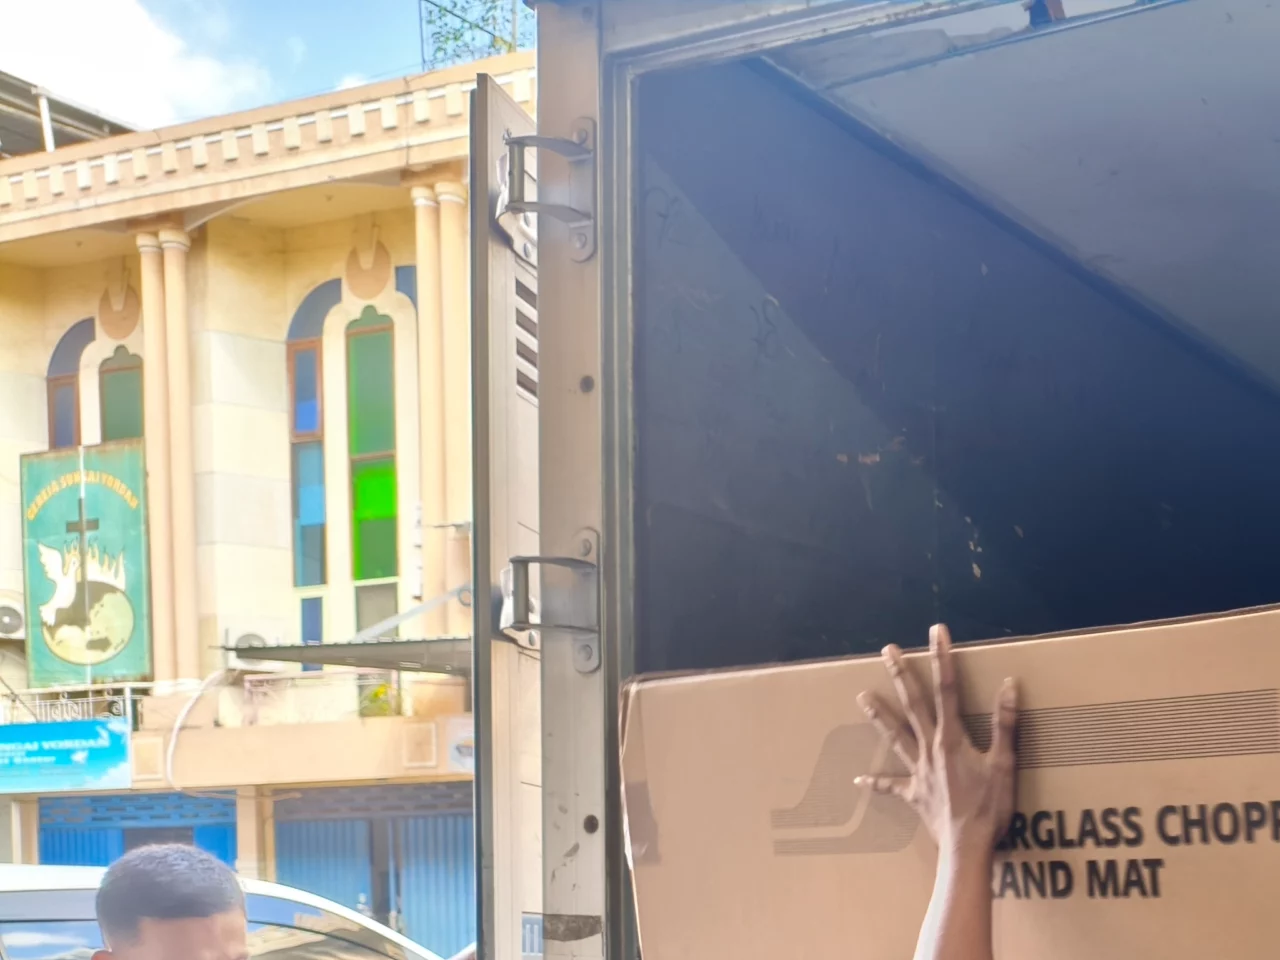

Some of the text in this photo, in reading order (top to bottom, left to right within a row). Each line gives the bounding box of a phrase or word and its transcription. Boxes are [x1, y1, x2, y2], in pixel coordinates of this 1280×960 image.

[994, 806, 1144, 852] RGLASS
[994, 858, 1165, 899] AND MAT
